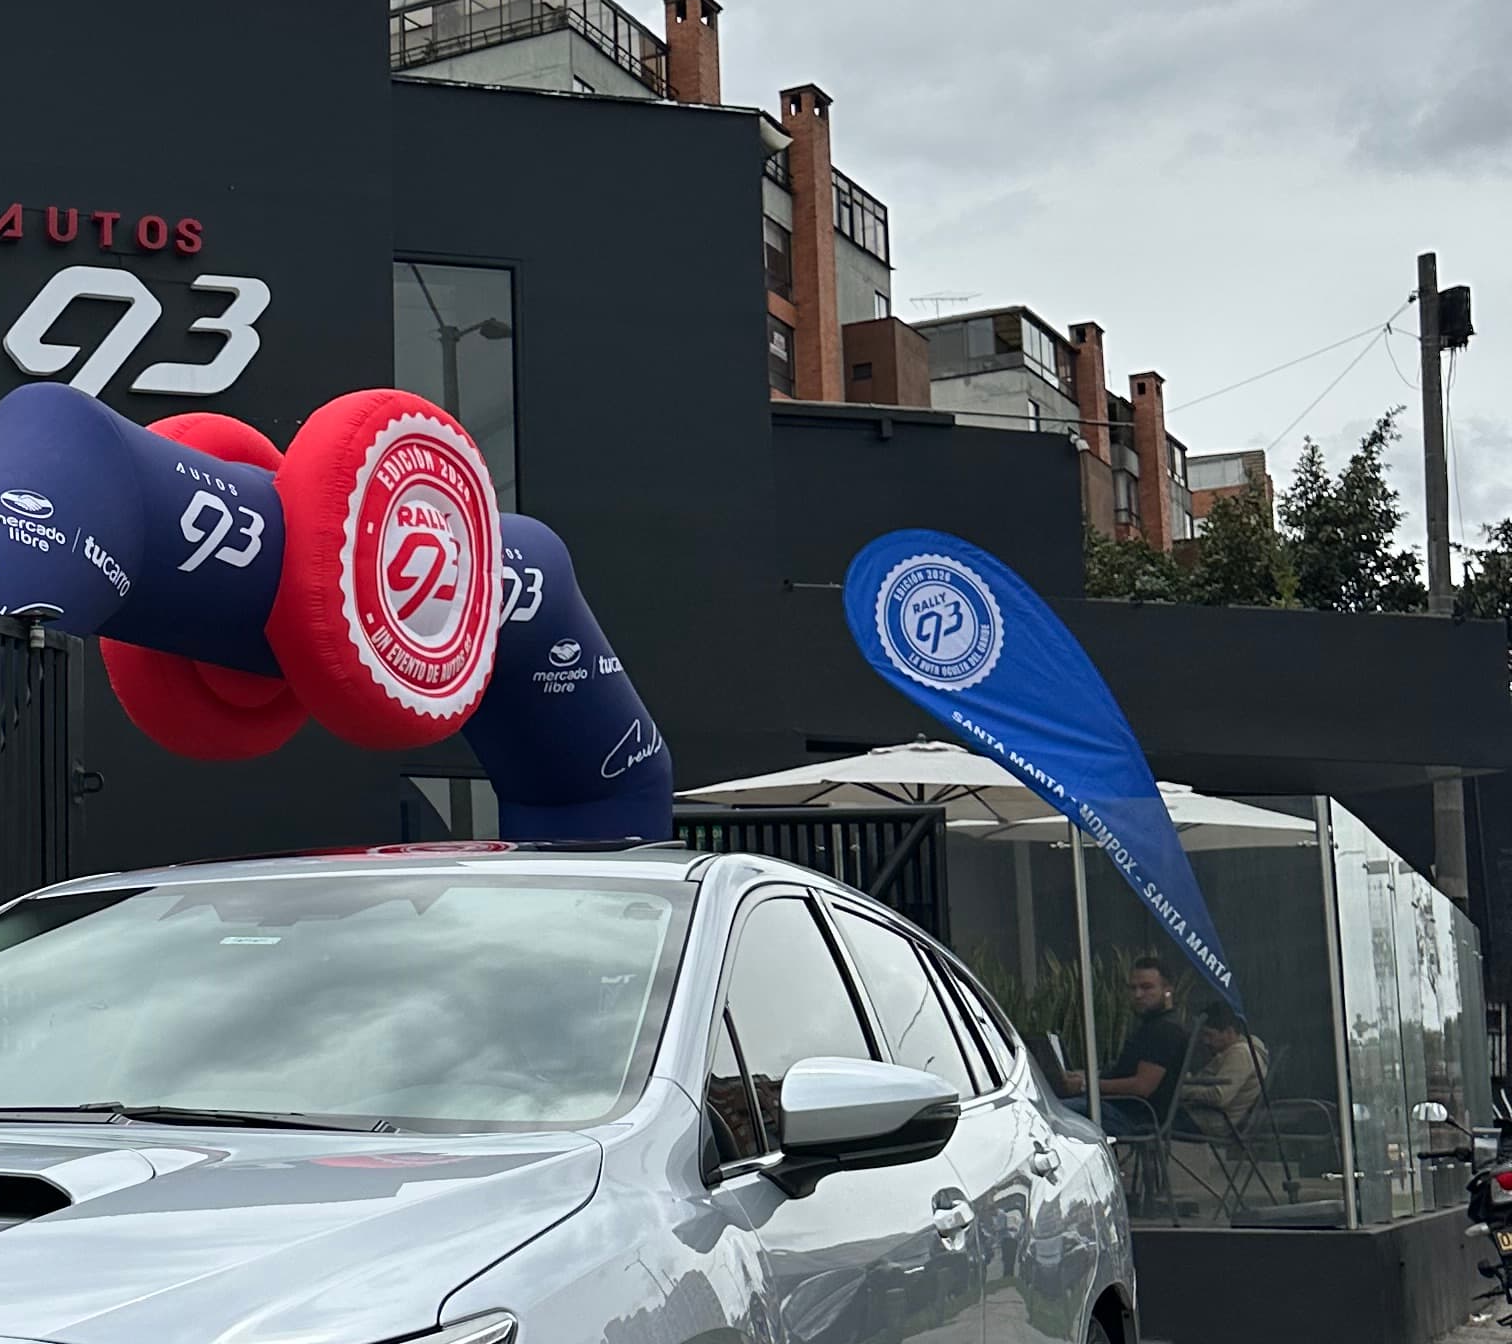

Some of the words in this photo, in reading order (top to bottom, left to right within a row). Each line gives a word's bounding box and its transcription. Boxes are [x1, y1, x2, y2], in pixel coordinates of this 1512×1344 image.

[2, 265, 271, 398] 93
[176, 462, 238, 497] AUTOS
[9, 526, 50, 552] libre
[177, 490, 265, 572] 93
[83, 535, 131, 598] tucarro
[912, 591, 946, 615] RALLY
[916, 600, 964, 654] 93
[533, 668, 588, 682] mercado
[543, 681, 576, 693] libre
[952, 711, 1005, 754] SANTA
[1009, 751, 1065, 798] MARTA
[1143, 882, 1186, 936] SANTA
[1185, 931, 1233, 988] MARTA
